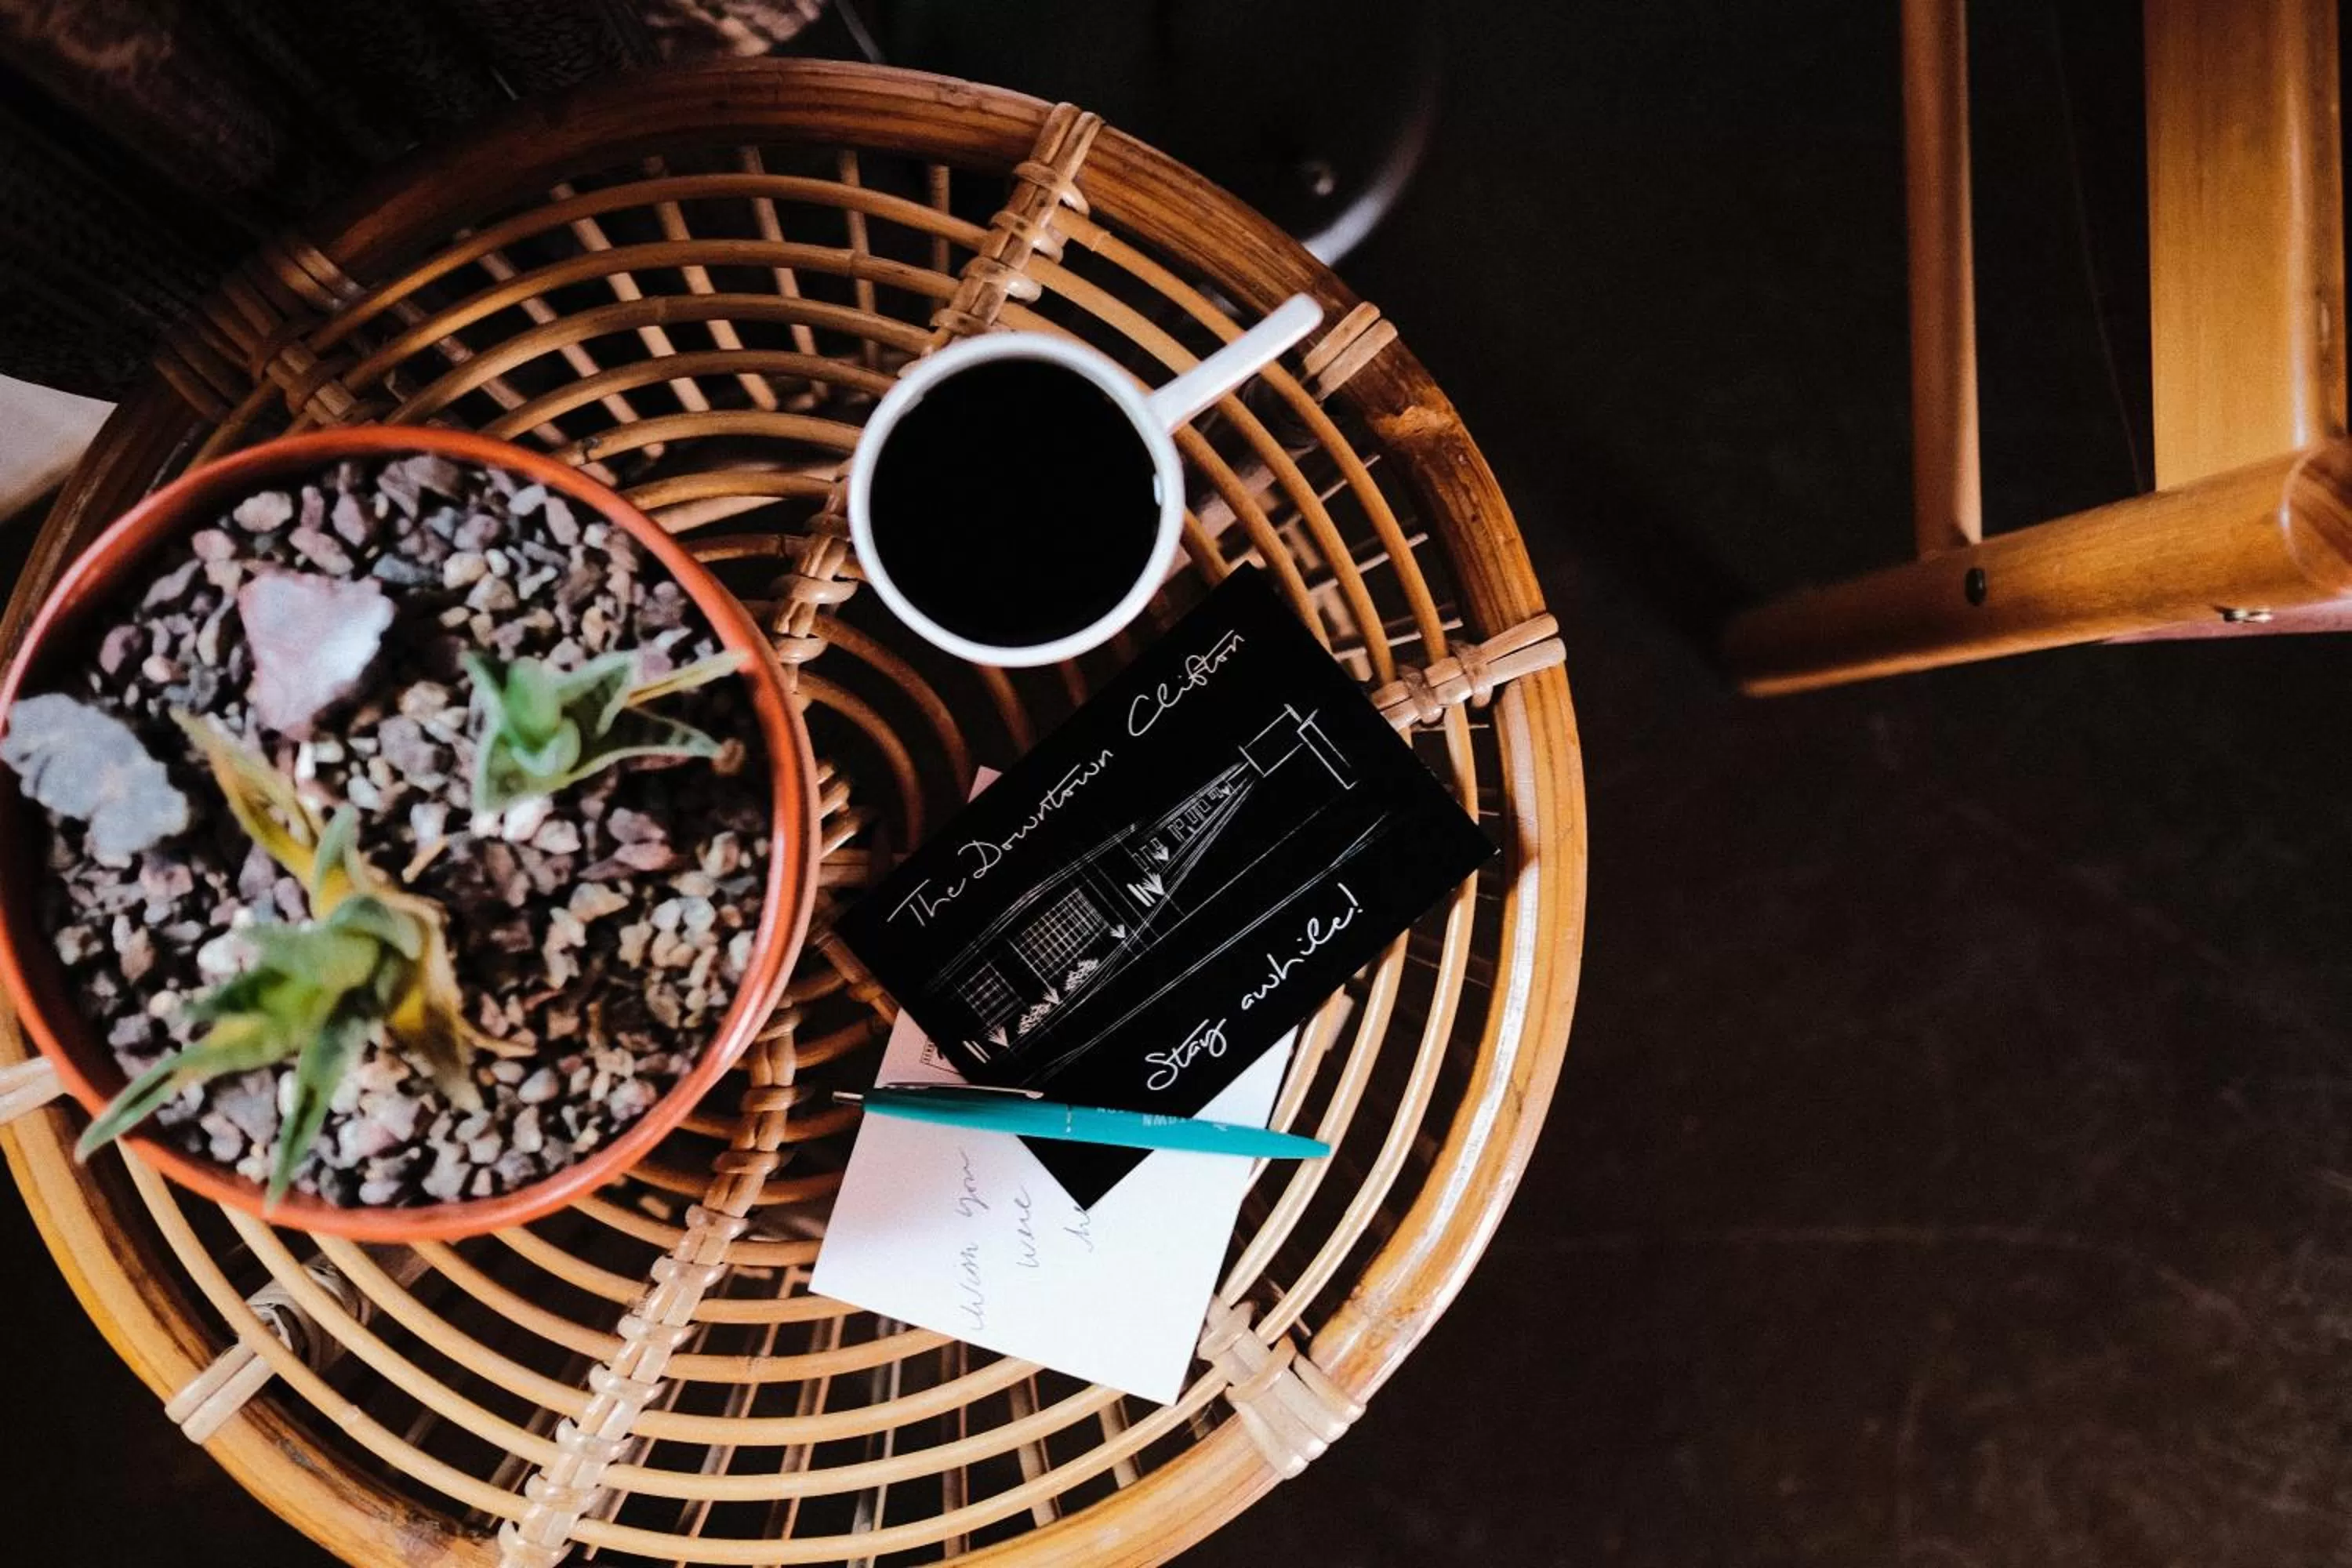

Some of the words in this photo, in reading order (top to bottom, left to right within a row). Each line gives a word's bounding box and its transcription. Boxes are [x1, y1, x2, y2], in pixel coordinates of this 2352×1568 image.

[887, 878, 967, 927] The
[957, 750, 1114, 879] Downtown
[1127, 630, 1245, 737] Clifton
[1144, 1018, 1227, 1091] Stay
[1241, 882, 1364, 1010] awhile!
